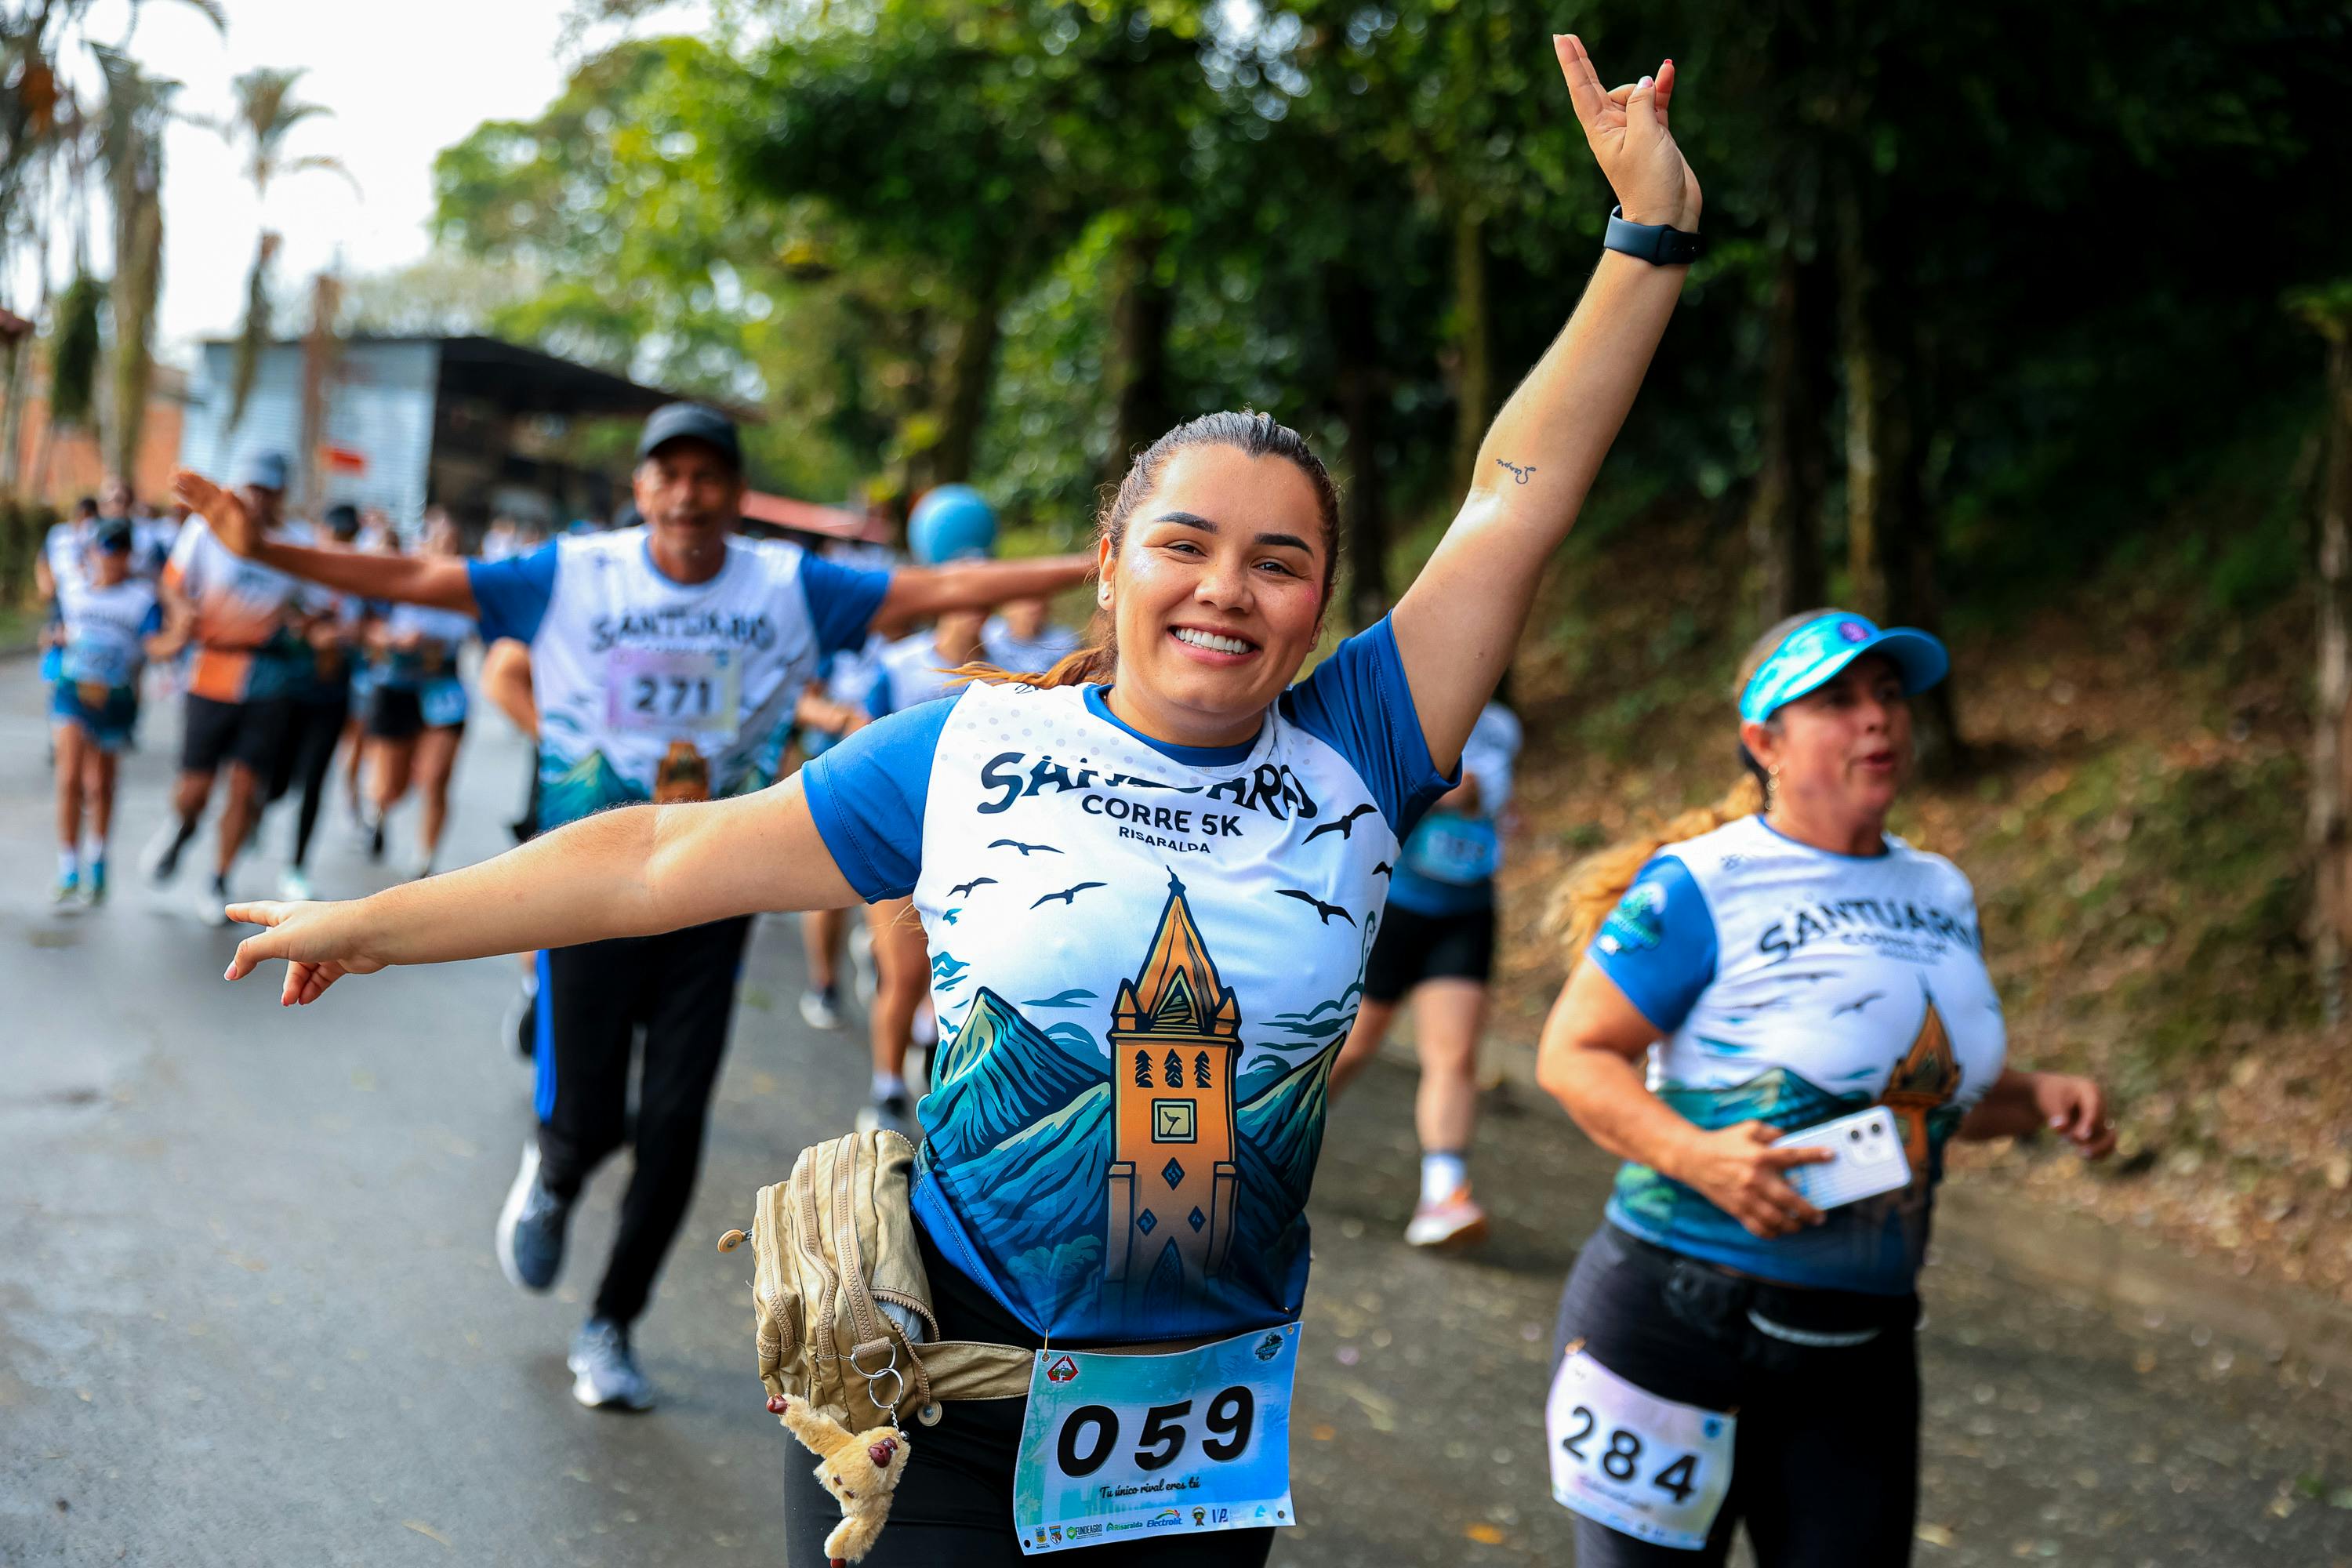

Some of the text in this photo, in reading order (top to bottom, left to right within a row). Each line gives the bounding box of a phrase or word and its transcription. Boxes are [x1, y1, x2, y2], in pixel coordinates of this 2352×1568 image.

[591, 606, 776, 652] SANTUARO
[637, 677, 711, 714] 271
[977, 752, 1318, 820] SAARO
[1082, 794, 1243, 837] CORRE 5K
[1119, 826, 1211, 855] RISARALDA
[1759, 899, 1980, 963] SANTUAR
[1057, 1385, 1254, 1479] 059
[1563, 1406, 1698, 1504] 284
[1100, 1476, 1201, 1498] Tu único rival eres tú
[1146, 1517, 1183, 1528] Electrolit
